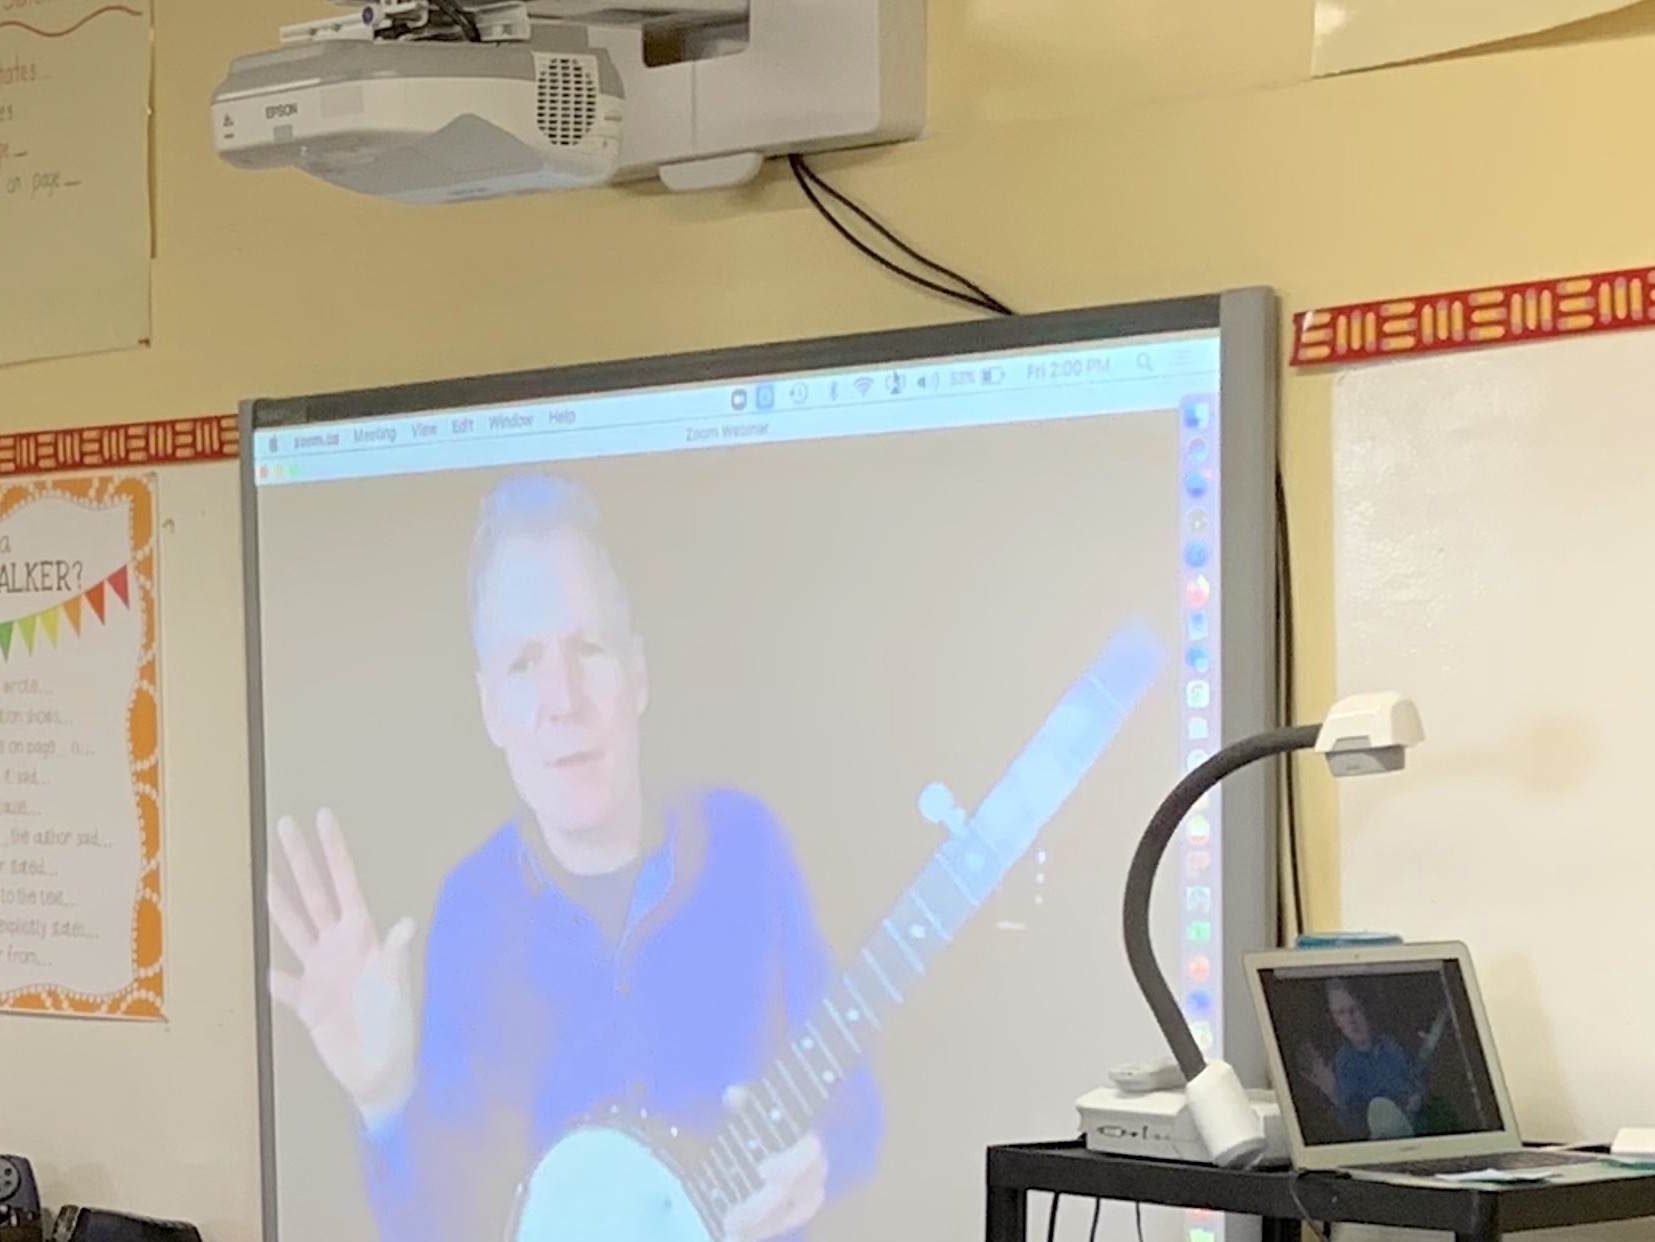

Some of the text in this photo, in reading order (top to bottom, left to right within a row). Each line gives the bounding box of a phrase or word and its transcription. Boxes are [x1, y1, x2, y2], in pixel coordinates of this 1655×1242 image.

[265, 103, 298, 119] EPSON
[7, 173, 22, 193] on
[1026, 364, 1045, 380] Fri
[1049, 360, 1081, 379] 2:00
[1085, 358, 1110, 375] PM
[353, 426, 395, 445] Meeting
[411, 424, 437, 438] View
[452, 419, 473, 434] Edit
[488, 413, 534, 430] Window
[549, 409, 576, 426] Help
[686, 421, 769, 442] Zoom Webinar
